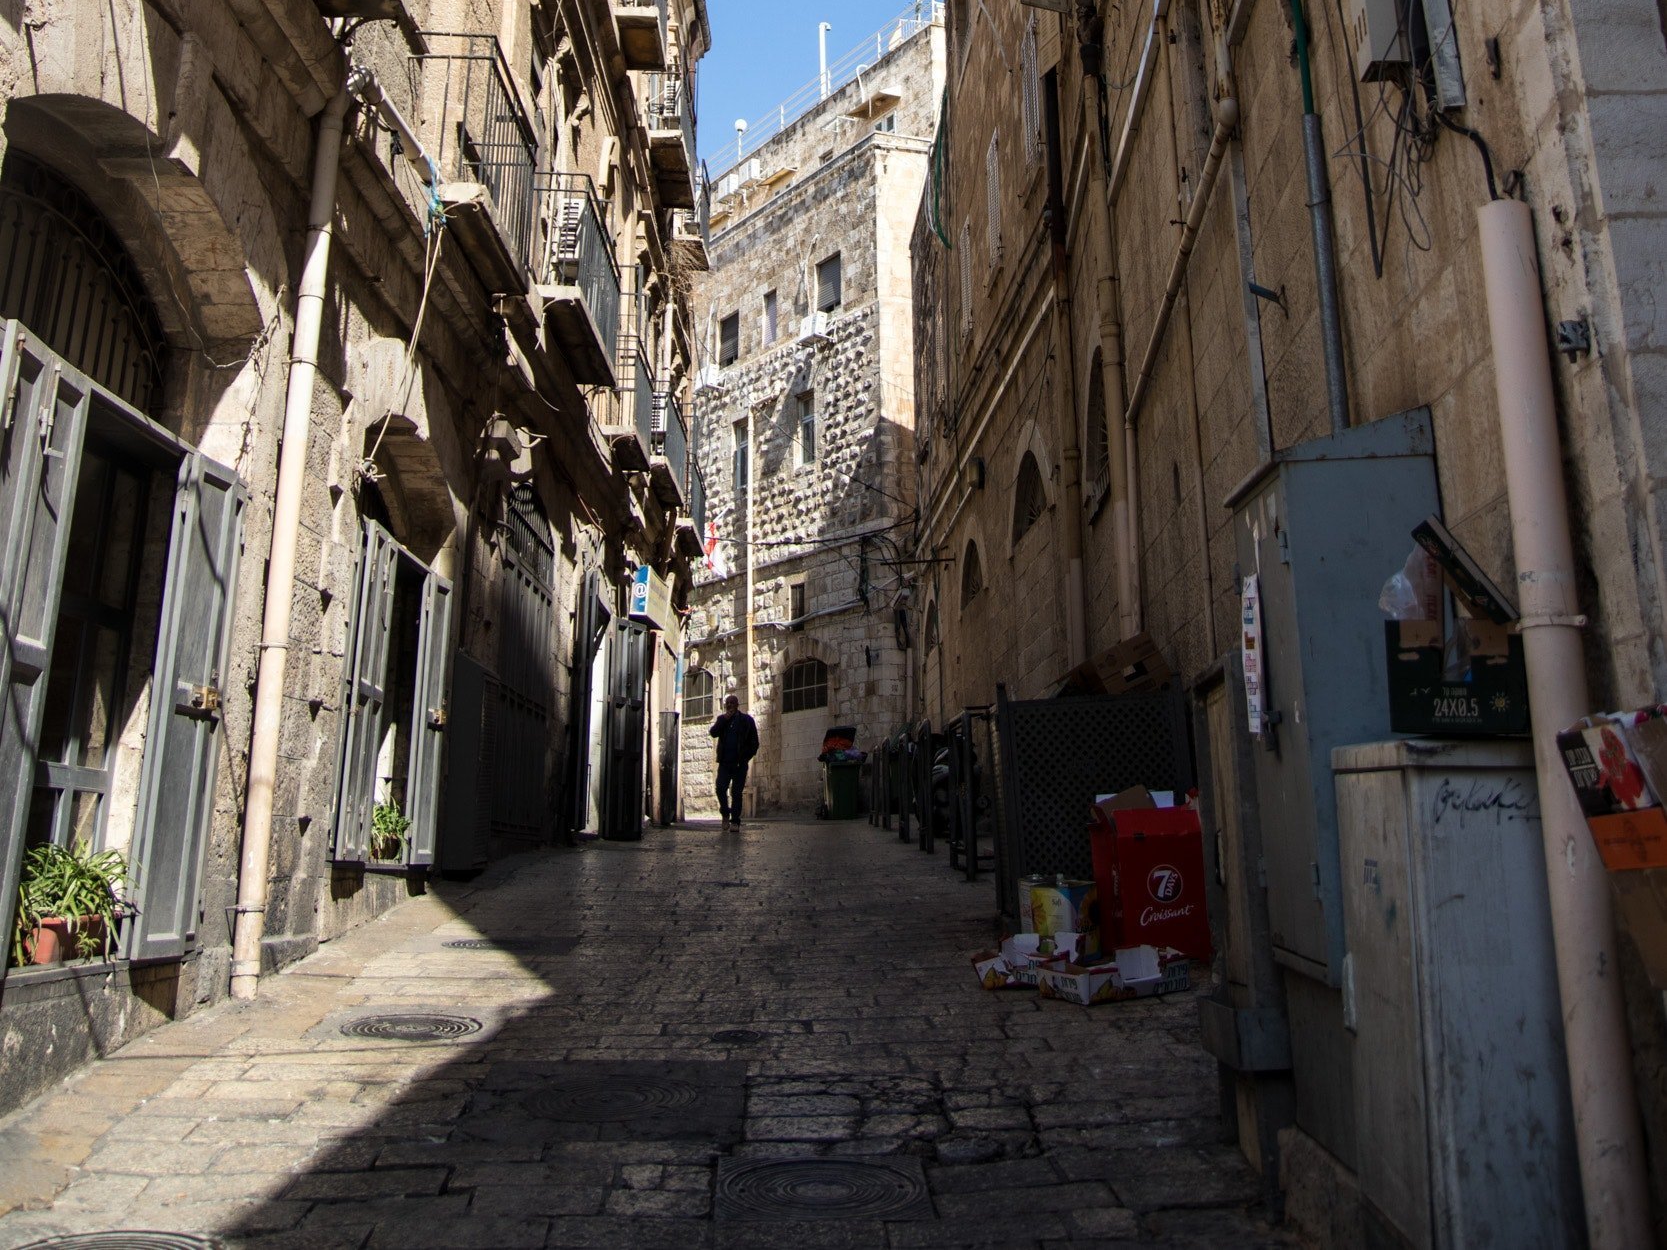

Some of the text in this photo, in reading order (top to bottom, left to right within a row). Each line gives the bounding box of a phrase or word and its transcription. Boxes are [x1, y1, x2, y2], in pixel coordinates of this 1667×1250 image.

[1152, 869, 1172, 898] 7
[1164, 872, 1179, 897] DAYS
[1140, 904, 1194, 926] Croissant
